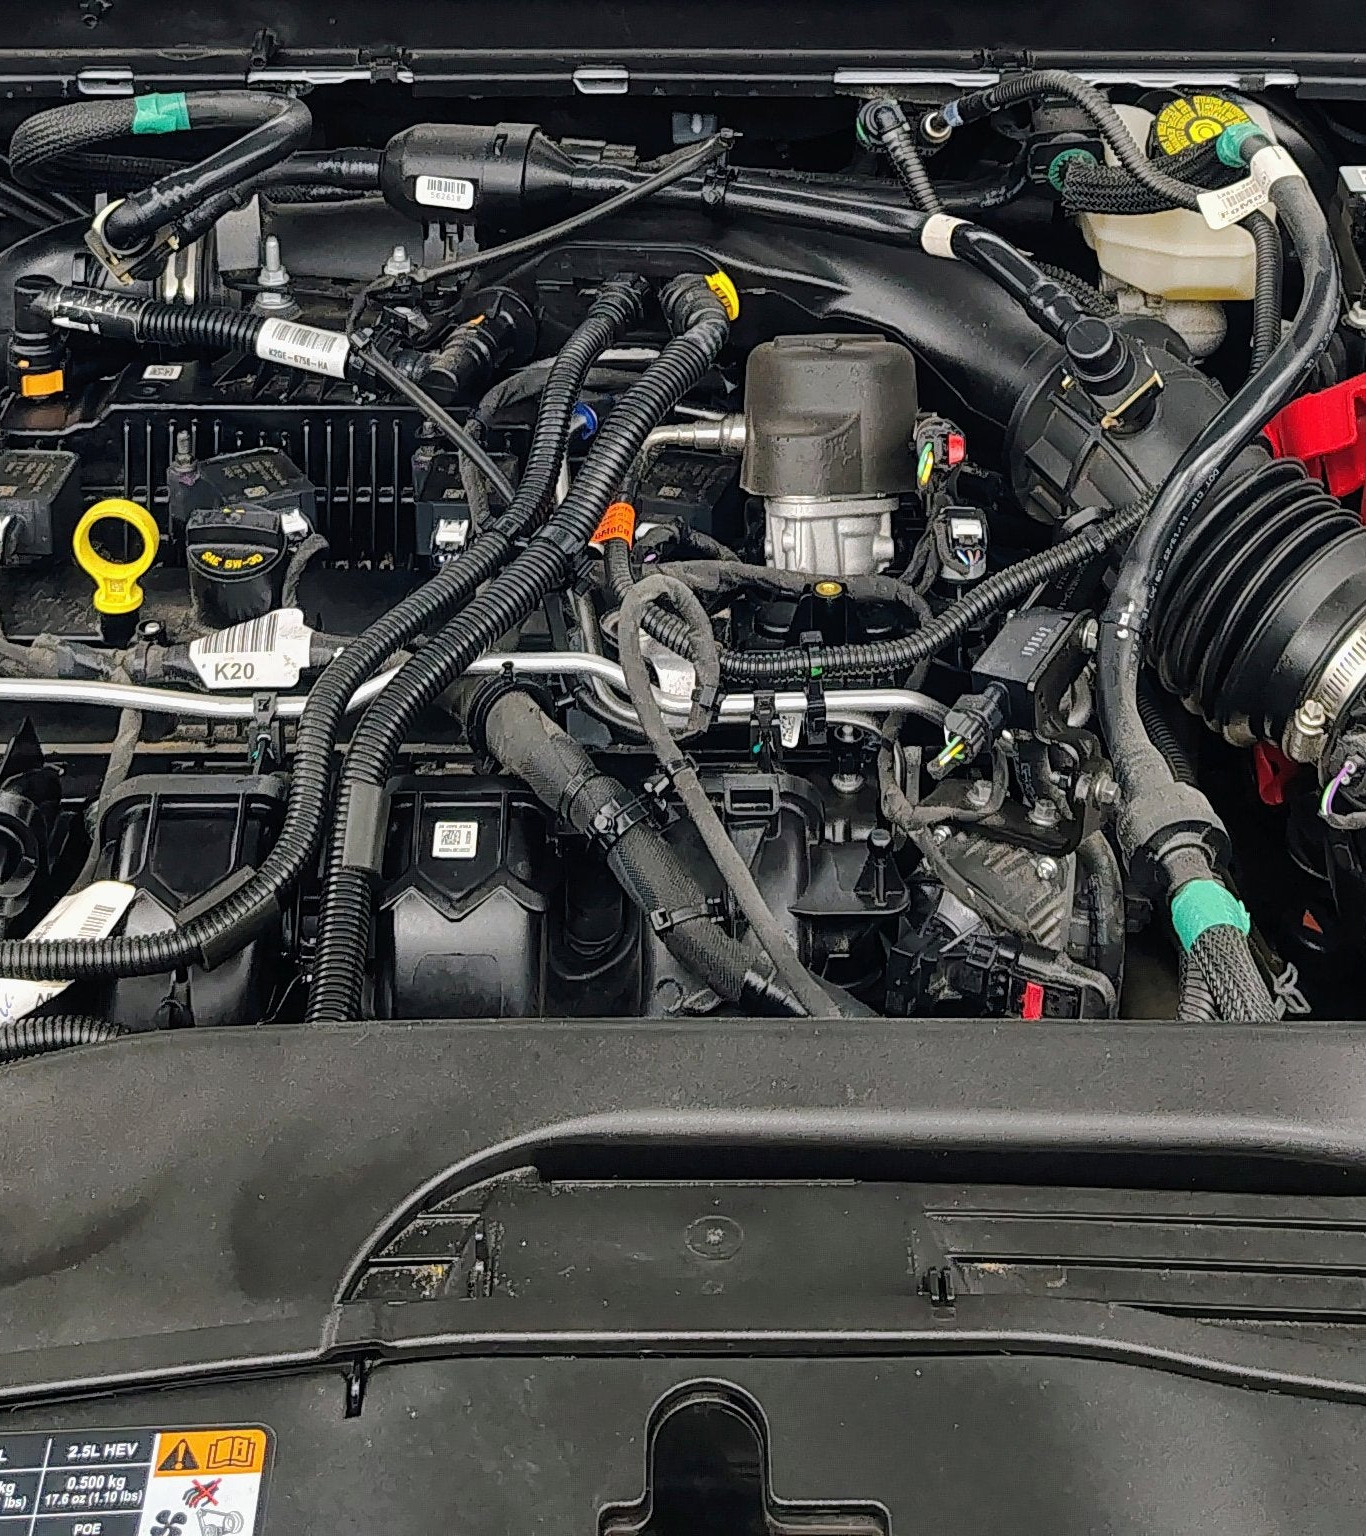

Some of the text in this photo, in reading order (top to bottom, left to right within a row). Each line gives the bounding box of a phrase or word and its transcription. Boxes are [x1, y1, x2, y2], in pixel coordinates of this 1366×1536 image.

[201, 551, 223, 566] SAE
[214, 662, 255, 681] K20
[67, 1445, 101, 1459] 2.5L
[103, 1442, 139, 1458] HEV
[66, 1474, 126, 1491] 0.500 kg
[4, 1496, 28, 1510] lbs)
[44, 1489, 144, 1507] 17.6 oz (1.10 lbs)
[73, 1523, 103, 1536] POE
